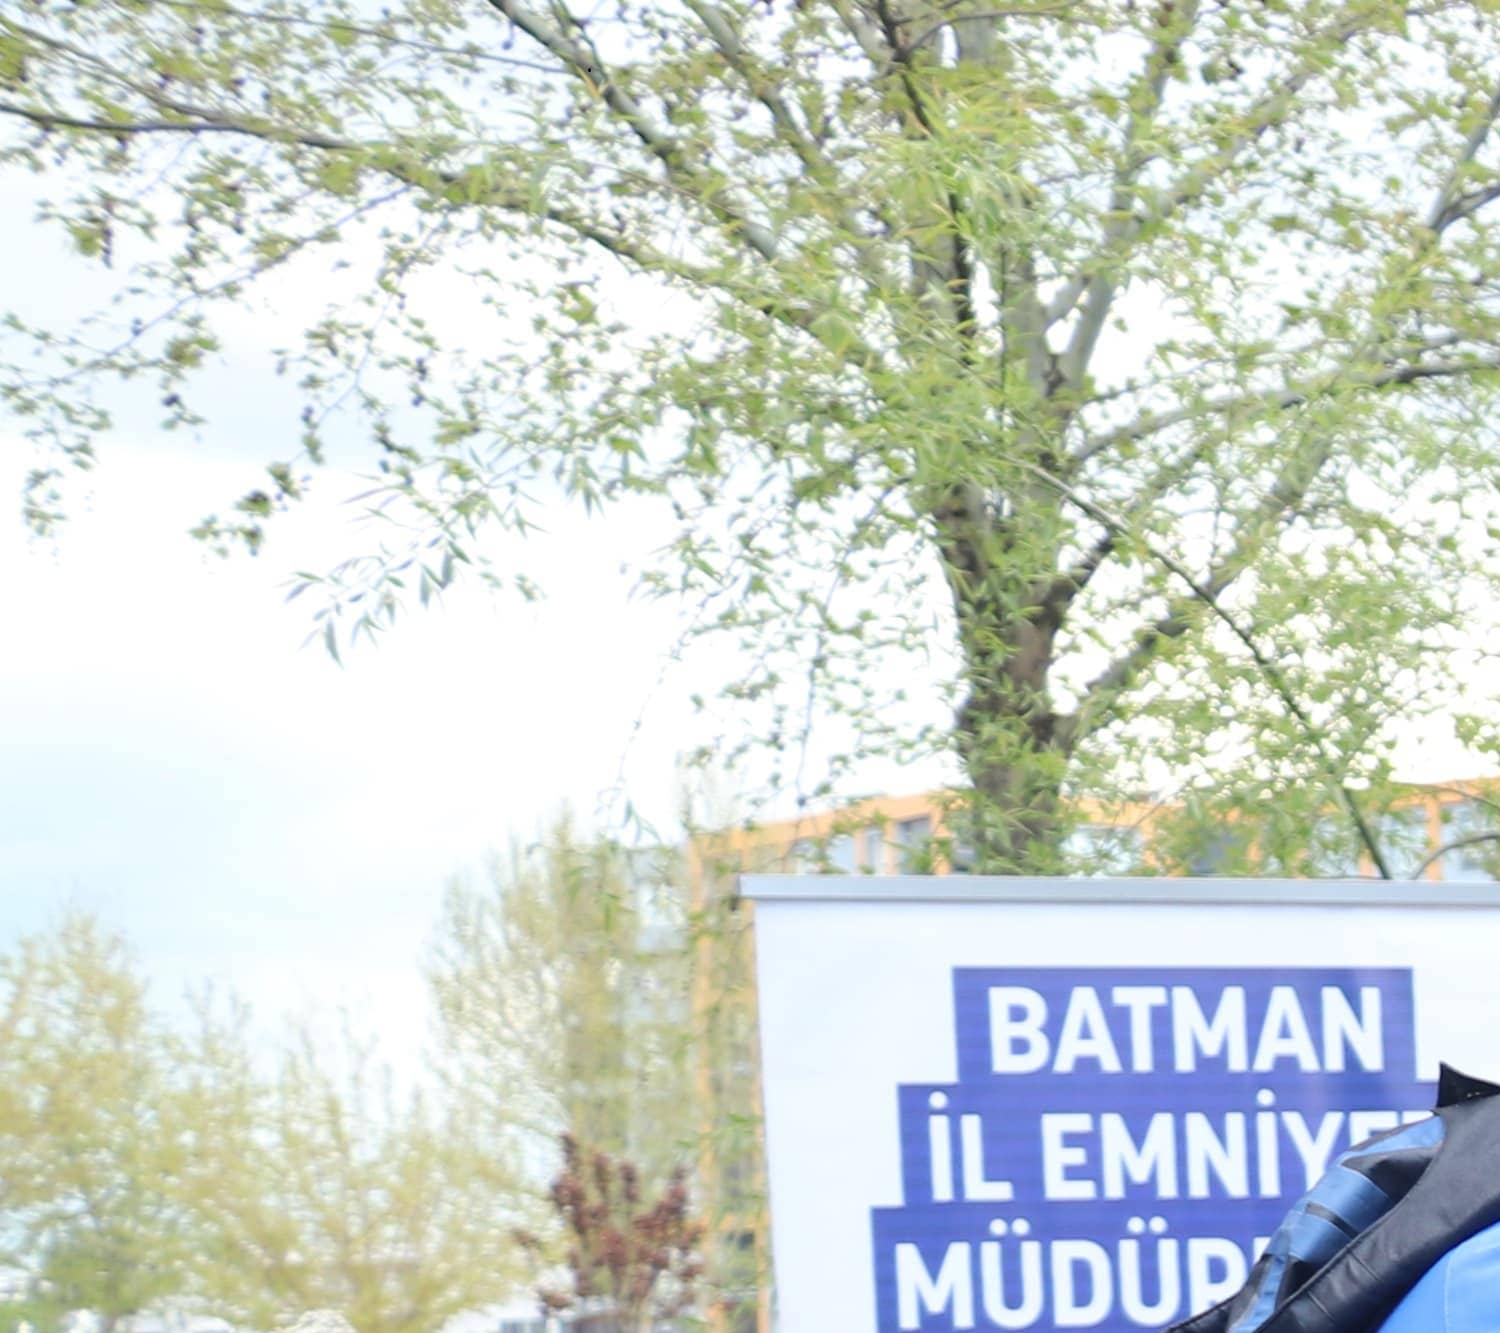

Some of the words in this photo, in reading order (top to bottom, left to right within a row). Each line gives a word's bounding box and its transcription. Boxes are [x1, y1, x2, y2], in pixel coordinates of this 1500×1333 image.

[987, 985, 1385, 1075] BATMAN
[929, 1090, 1013, 1202] İL
[1042, 1088, 1436, 1201] EMNİY
[893, 1217, 1271, 1332] MÜDÜR
